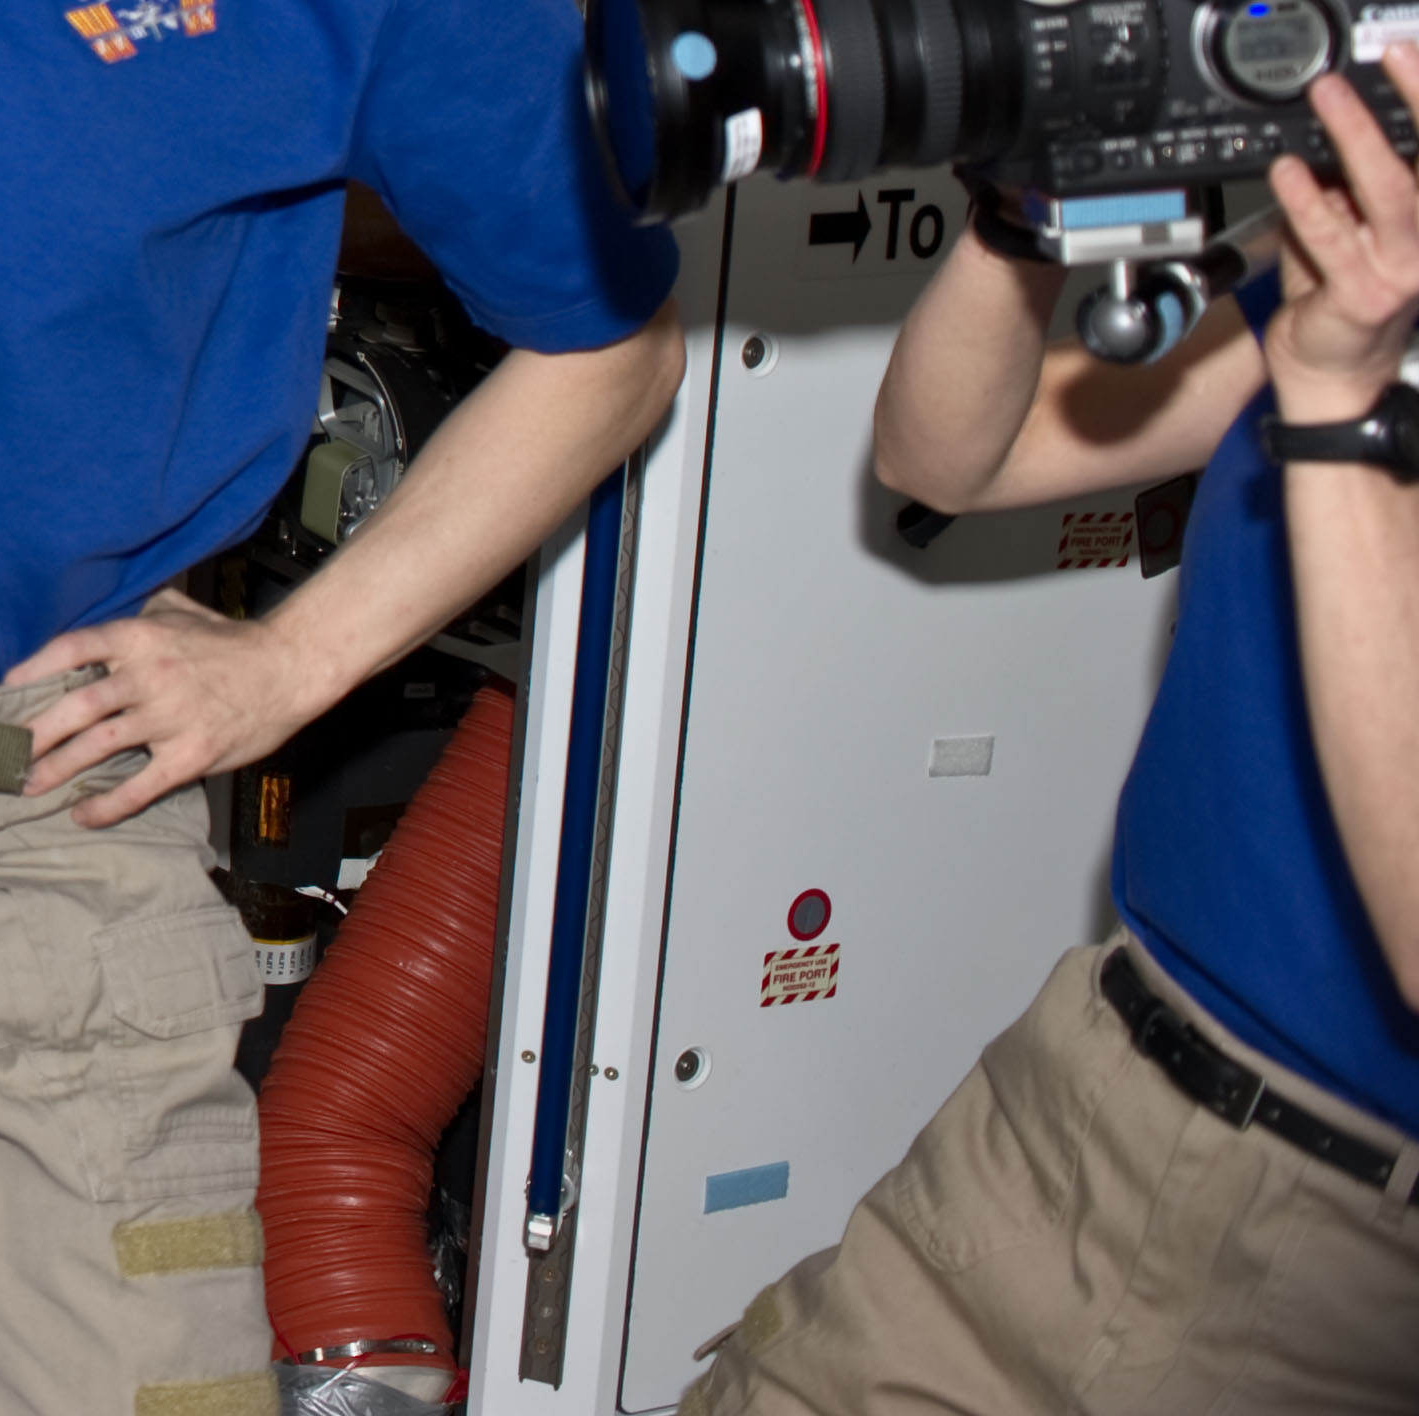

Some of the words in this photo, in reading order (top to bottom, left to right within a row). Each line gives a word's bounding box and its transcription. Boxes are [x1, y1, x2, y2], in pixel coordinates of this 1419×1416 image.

[877, 188, 945, 260] To
[1094, 536, 1121, 547] PORT
[775, 960, 813, 971] EMERGENCY
[773, 972, 796, 984] FIRE
[799, 968, 827, 981] PORT
